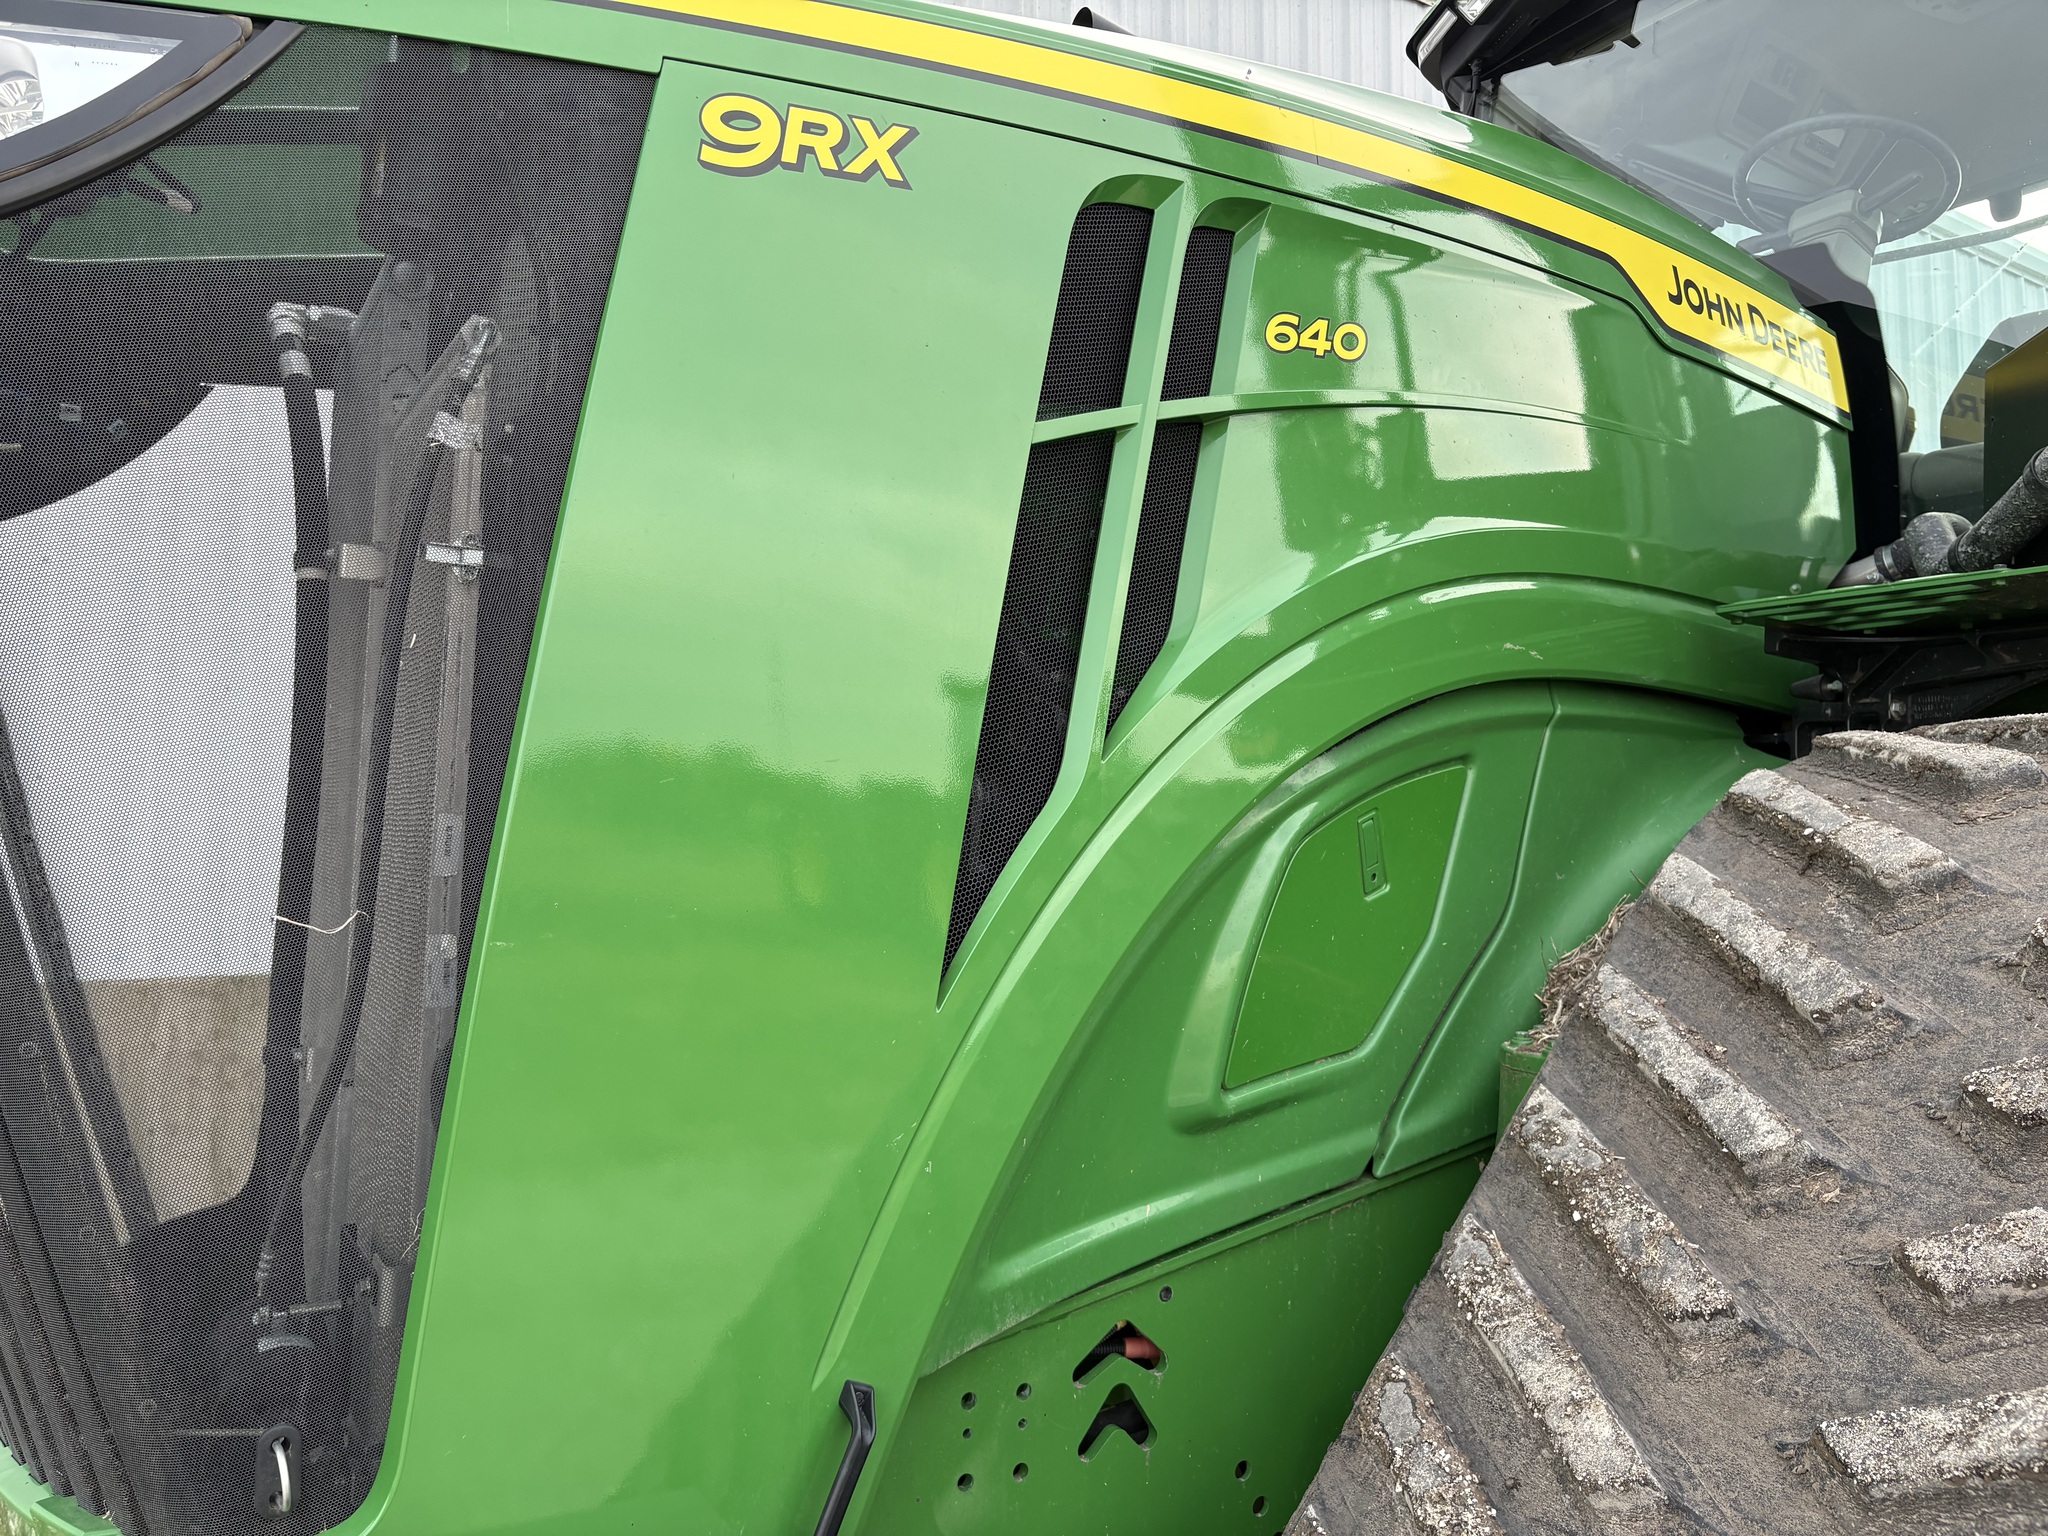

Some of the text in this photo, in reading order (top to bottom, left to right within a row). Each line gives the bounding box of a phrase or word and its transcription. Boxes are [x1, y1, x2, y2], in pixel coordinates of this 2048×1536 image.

[697, 92, 921, 191] 9RX
[1265, 311, 1368, 362] 640
[1667, 265, 1831, 380] JOHN DEERE
